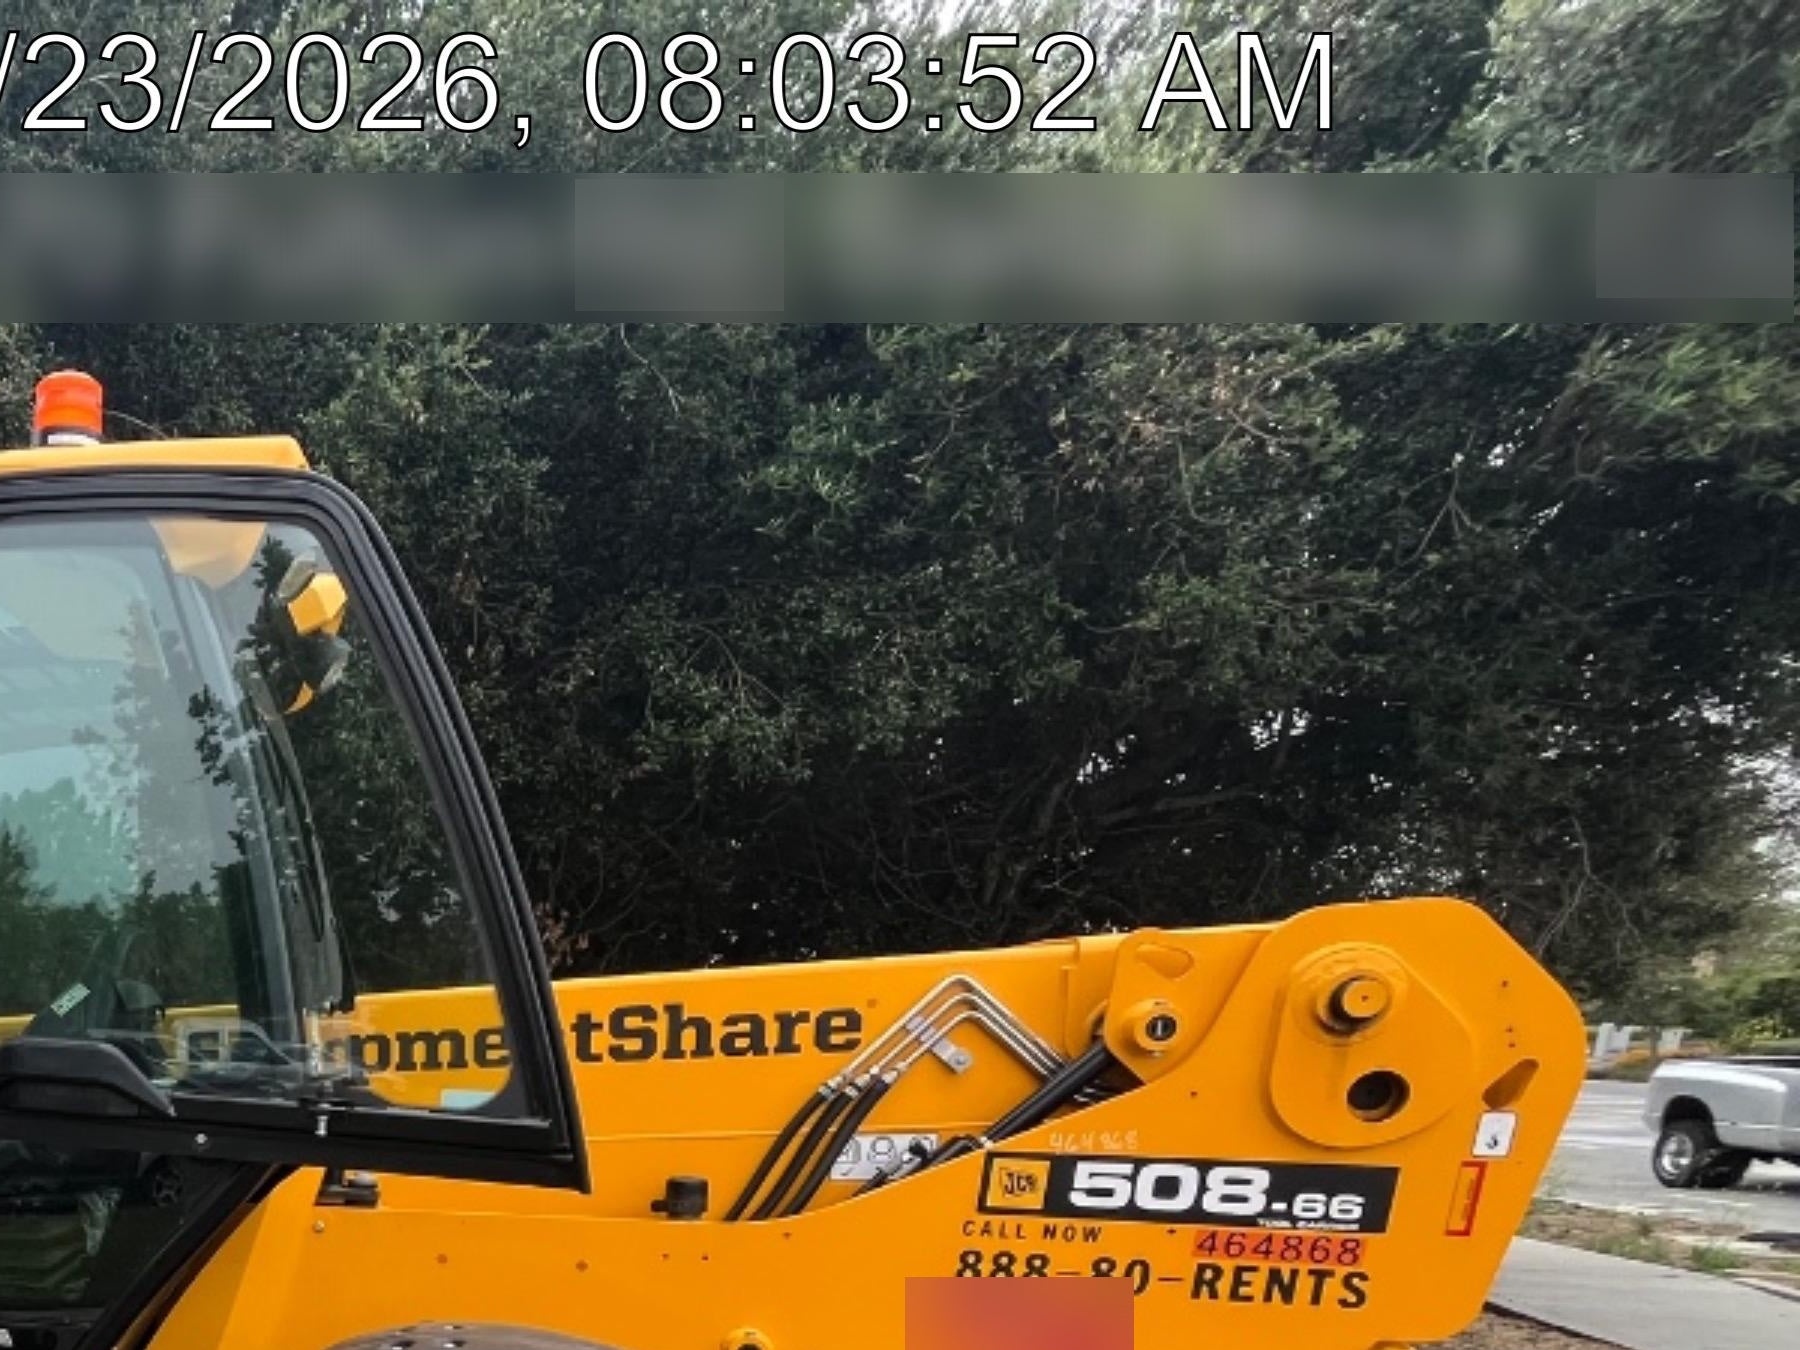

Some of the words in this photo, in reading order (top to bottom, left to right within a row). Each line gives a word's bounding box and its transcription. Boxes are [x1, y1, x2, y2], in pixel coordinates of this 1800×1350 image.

[962, 1219, 1029, 1241] CALL
[1042, 1223, 1103, 1243] NOW
[1196, 1231, 1362, 1267] 464868
